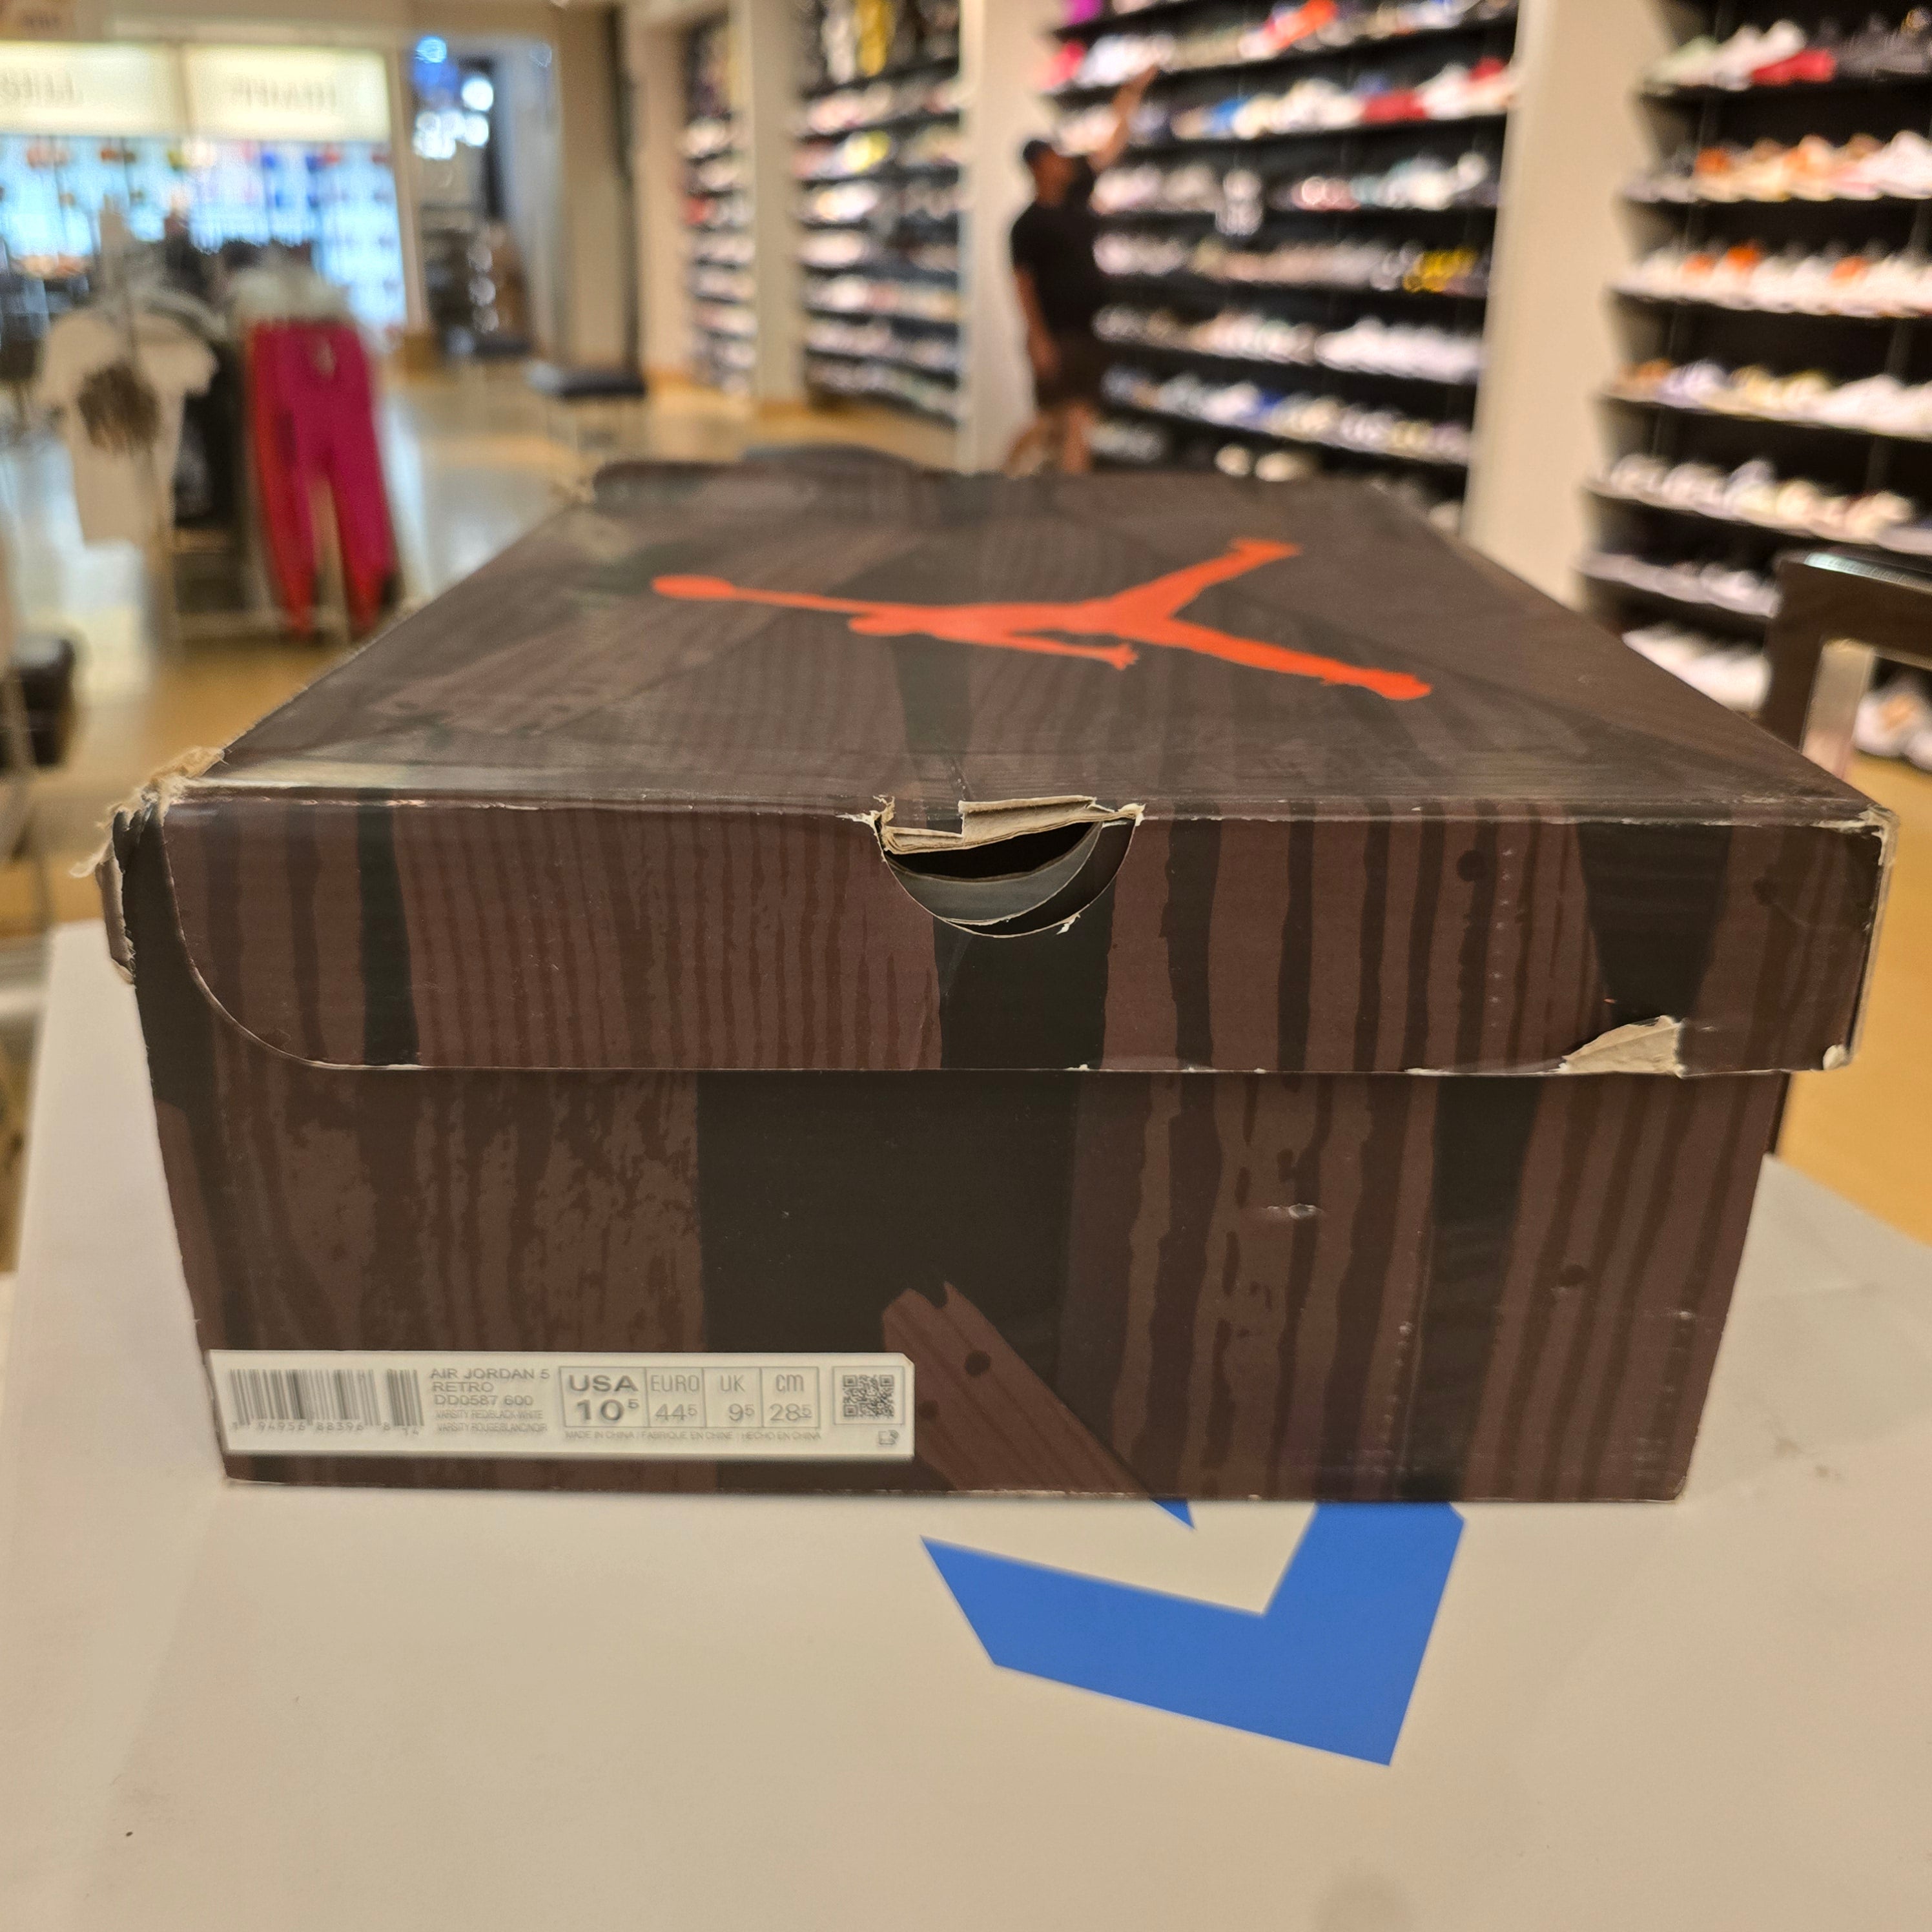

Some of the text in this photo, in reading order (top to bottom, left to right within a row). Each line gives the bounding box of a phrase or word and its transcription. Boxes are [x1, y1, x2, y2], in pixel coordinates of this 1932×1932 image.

[430, 1368, 550, 1380] AIR JORDAN 5
[432, 1381, 495, 1393] RETRO
[569, 1375, 639, 1392] USA
[650, 1374, 700, 1393] EURO
[720, 1375, 745, 1393] UK
[434, 1394, 534, 1406] DD0587 600
[564, 1430, 592, 1440] MADE
[605, 1430, 635, 1440] CHINA
[690, 1431, 703, 1441] EN
[777, 1432, 791, 1441] EN
